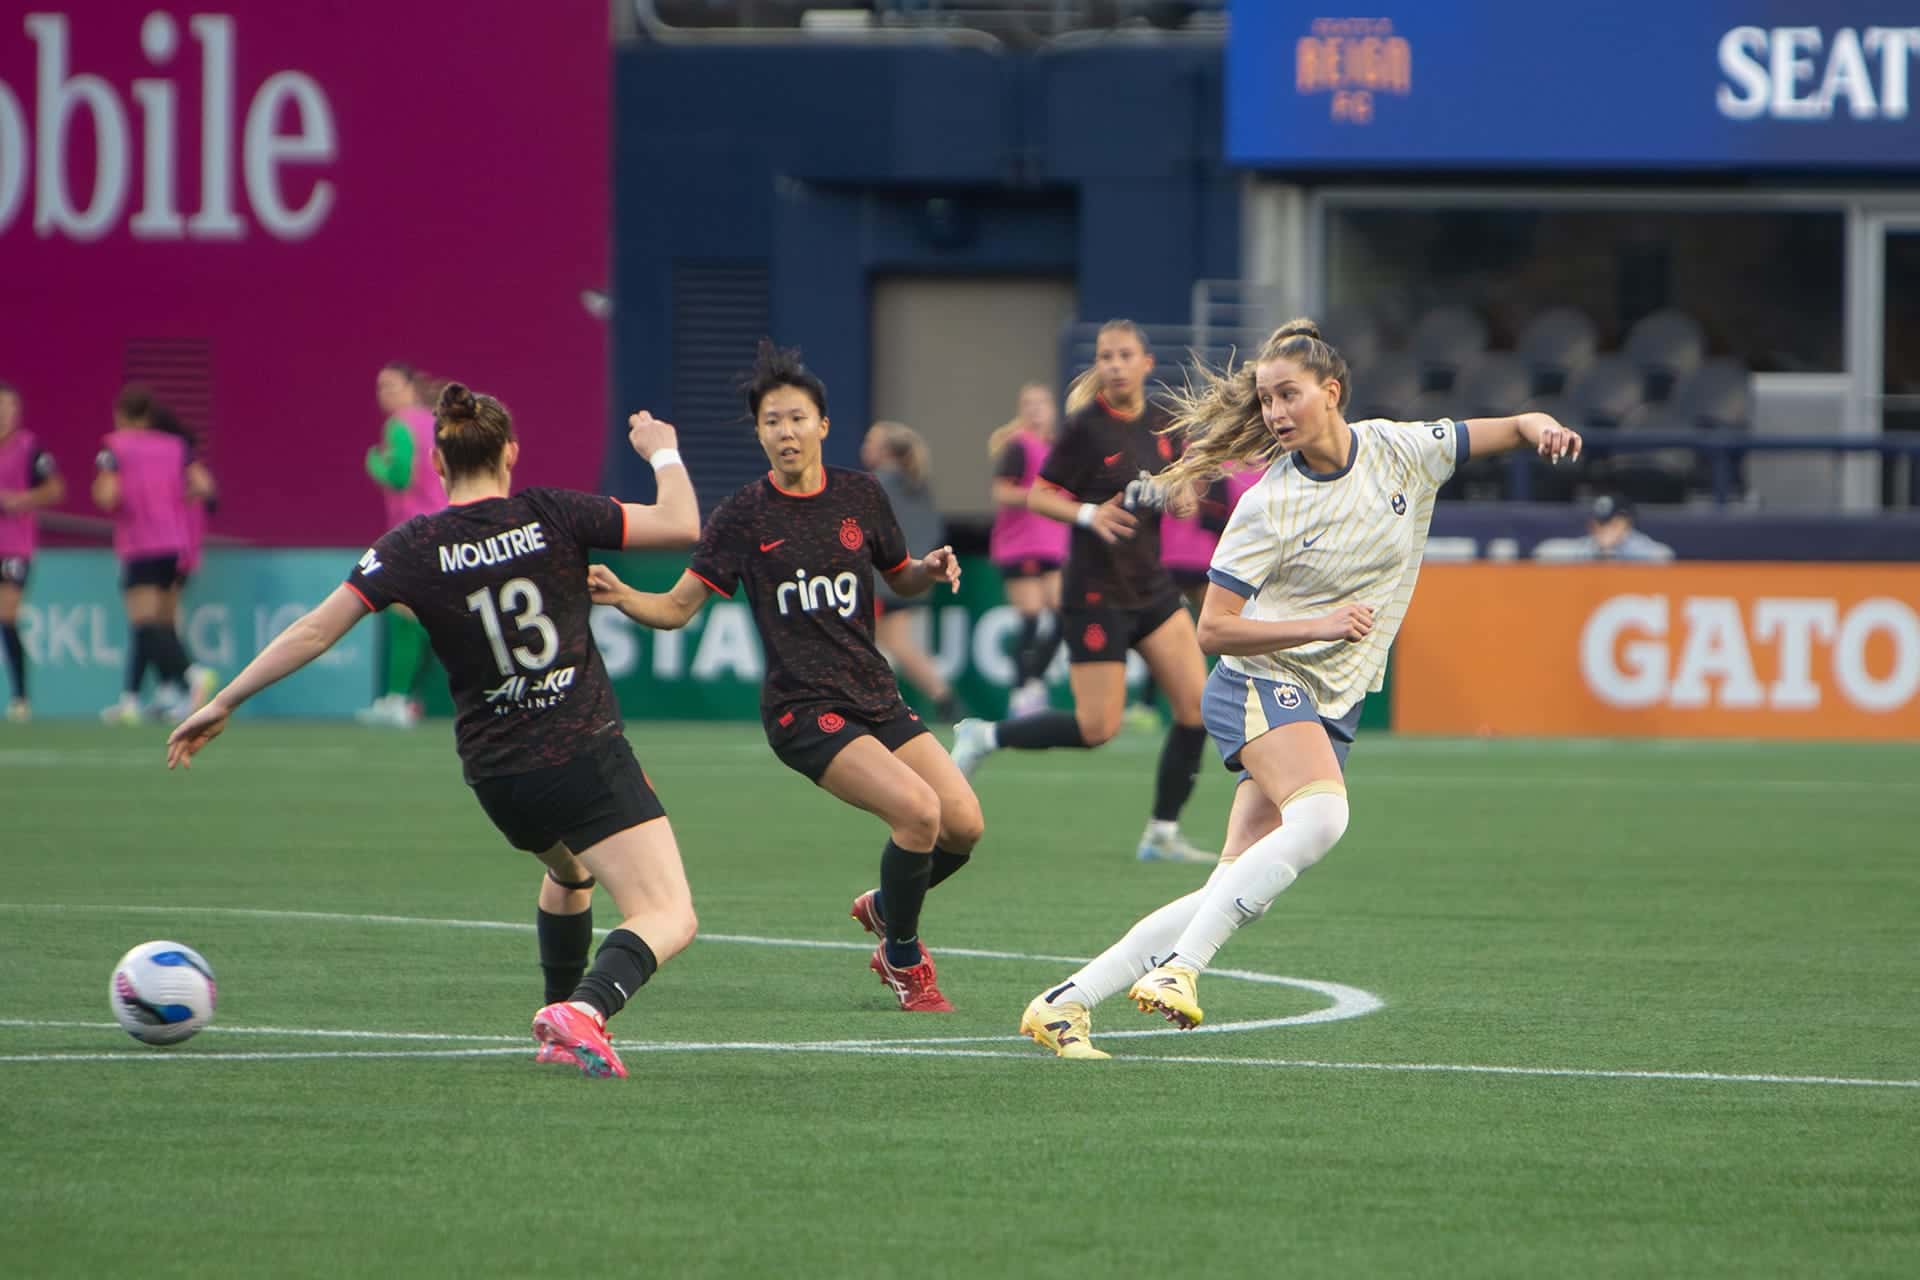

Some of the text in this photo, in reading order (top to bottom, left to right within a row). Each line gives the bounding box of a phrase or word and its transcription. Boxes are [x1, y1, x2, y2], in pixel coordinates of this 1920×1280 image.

[0, 10, 338, 242] bile
[438, 521, 546, 573] MOULTRIE
[776, 568, 858, 618] ring
[466, 577, 559, 676] 13
[1581, 593, 1920, 709] GATO
